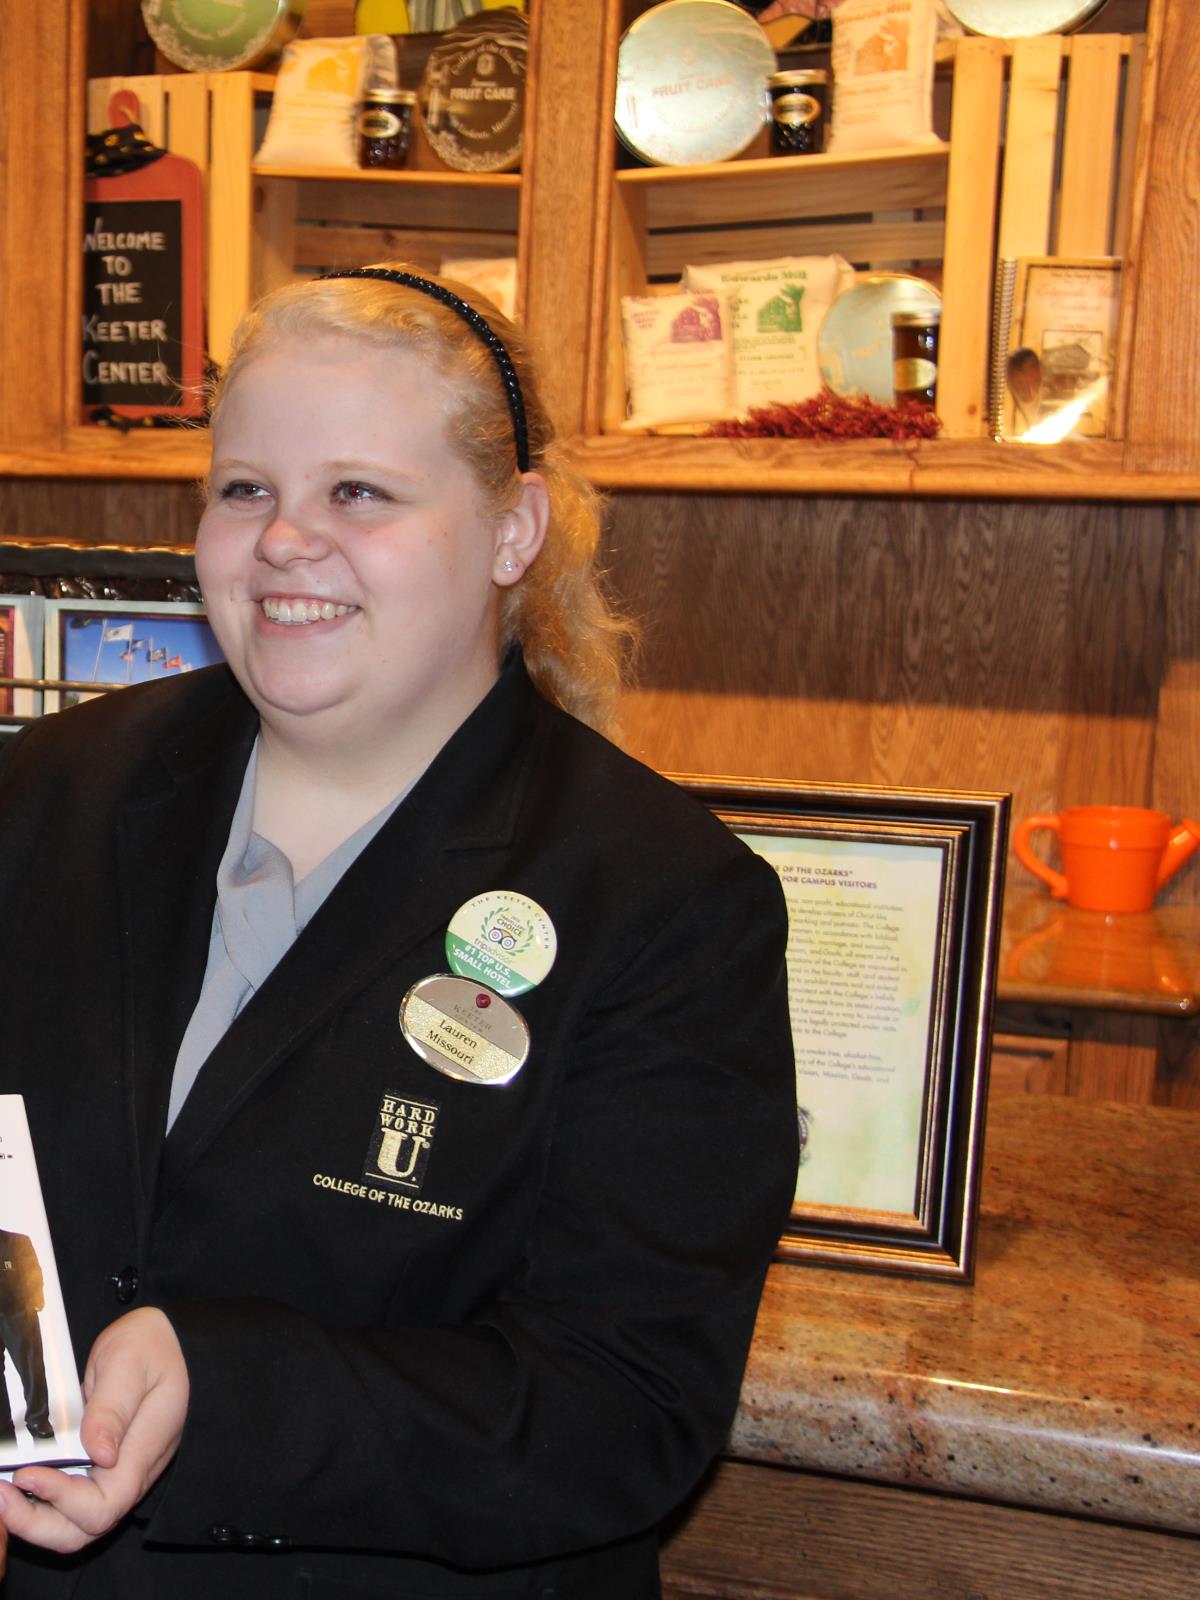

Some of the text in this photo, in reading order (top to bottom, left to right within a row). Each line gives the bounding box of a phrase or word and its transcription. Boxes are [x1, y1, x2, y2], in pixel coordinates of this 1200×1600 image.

[450, 87, 517, 100] FRUIT CAKE
[653, 82, 691, 97] FRUIT
[84, 217, 167, 252] WELCOME
[101, 255, 132, 277] TO
[96, 281, 144, 305] THE
[82, 314, 169, 345] KEETER
[83, 350, 169, 387] CENTER
[797, 866, 812, 874] THE
[801, 877, 836, 886] CAMPUS
[839, 880, 877, 889] VISITORS
[472, 898, 489, 907] THE
[497, 896, 531, 909] KEETER
[535, 913, 549, 949] CENTER
[497, 918, 523, 937] CHOICE
[453, 948, 512, 988] SMALL HOTEL
[464, 945, 511, 978] #1 TOP U.S.
[426, 1030, 475, 1064] Missouri
[439, 1019, 477, 1049] Lauren
[381, 1099, 436, 1124] HARD
[380, 1113, 435, 1138] WORK
[313, 1174, 464, 1221] COLLEGE OF THE OZARKS
